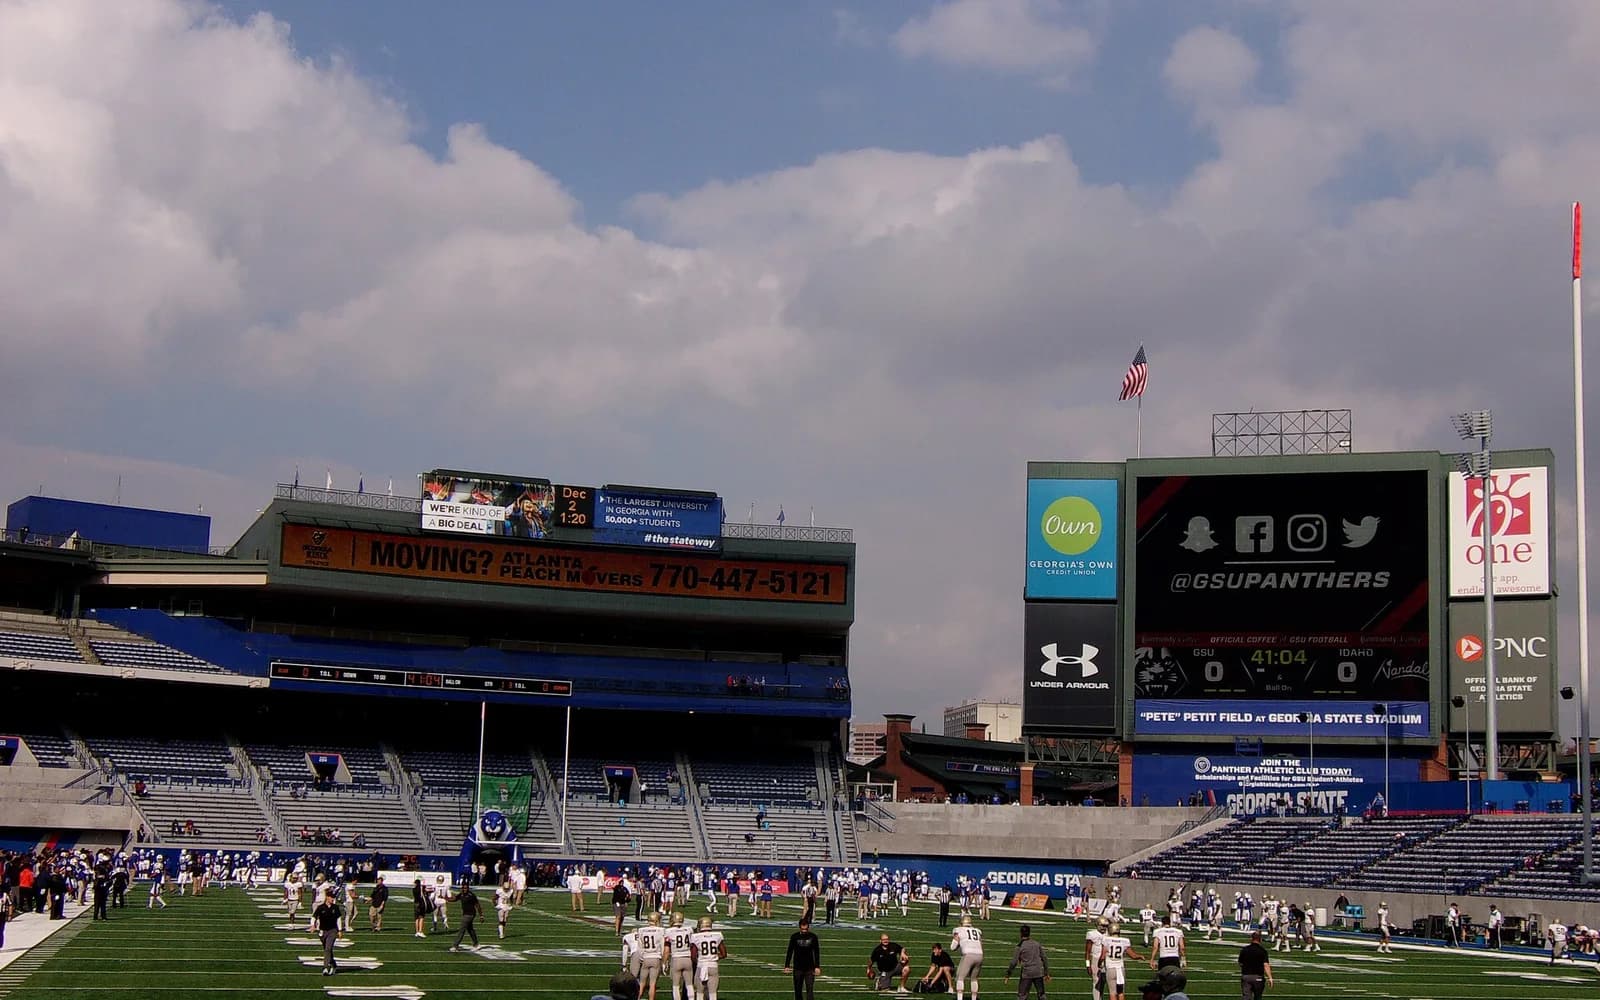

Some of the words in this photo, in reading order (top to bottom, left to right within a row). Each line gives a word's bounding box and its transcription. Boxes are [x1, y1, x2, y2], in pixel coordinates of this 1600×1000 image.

[562, 488, 586, 499] Dec
[569, 501, 576, 512] 2
[606, 496, 622, 504] THE
[624, 498, 660, 508] LARGEST
[663, 501, 708, 511] UNIVERSITY
[430, 504, 460, 514] WE'RE
[462, 506, 486, 516] KIND
[488, 508, 502, 518] OF
[560, 512, 586, 524] 1:20
[615, 507, 650, 516] GEORGIA
[652, 509, 672, 518] WITH
[428, 518, 436, 527] A
[438, 520, 455, 528] BIG
[456, 521, 484, 531] DEAL
[606, 515, 638, 524] 50,000+
[640, 518, 680, 528] STUDENTS
[1046, 514, 1096, 535] Own
[644, 534, 715, 548] #thestateway
[371, 540, 493, 576] MOVING?
[502, 552, 584, 569] ATLANTA
[1466, 542, 1532, 565] one
[1089, 561, 1113, 569] OWN
[500, 565, 560, 581] PEACH
[650, 563, 830, 596] 770-447-5121
[1171, 572, 1391, 592] @GSUPANTHERS
[1210, 636, 1244, 644] OFFICIAL
[1246, 636, 1278, 644] COFFEE
[1308, 636, 1348, 644] FOOTBALL
[1493, 636, 1547, 658] PNC
[1193, 648, 1214, 656] GSU
[1251, 650, 1308, 664] 41:04
[1340, 648, 1374, 656] IDAHO
[1204, 661, 1224, 682] 0
[1338, 662, 1357, 682] 0
[408, 673, 441, 686] 41:04
[1184, 712, 1216, 722] PETIT
[1220, 712, 1252, 722] FIELD
[1325, 714, 1362, 724] STATE
[1366, 714, 1422, 724] STADIUM
[988, 872, 1050, 886] GEORGIA
[644, 936, 656, 948] 81
[676, 935, 690, 948] 84
[701, 941, 718, 956] 86
[966, 930, 978, 940] 19
[1164, 936, 1176, 948] 10
[1109, 946, 1122, 959] 12
